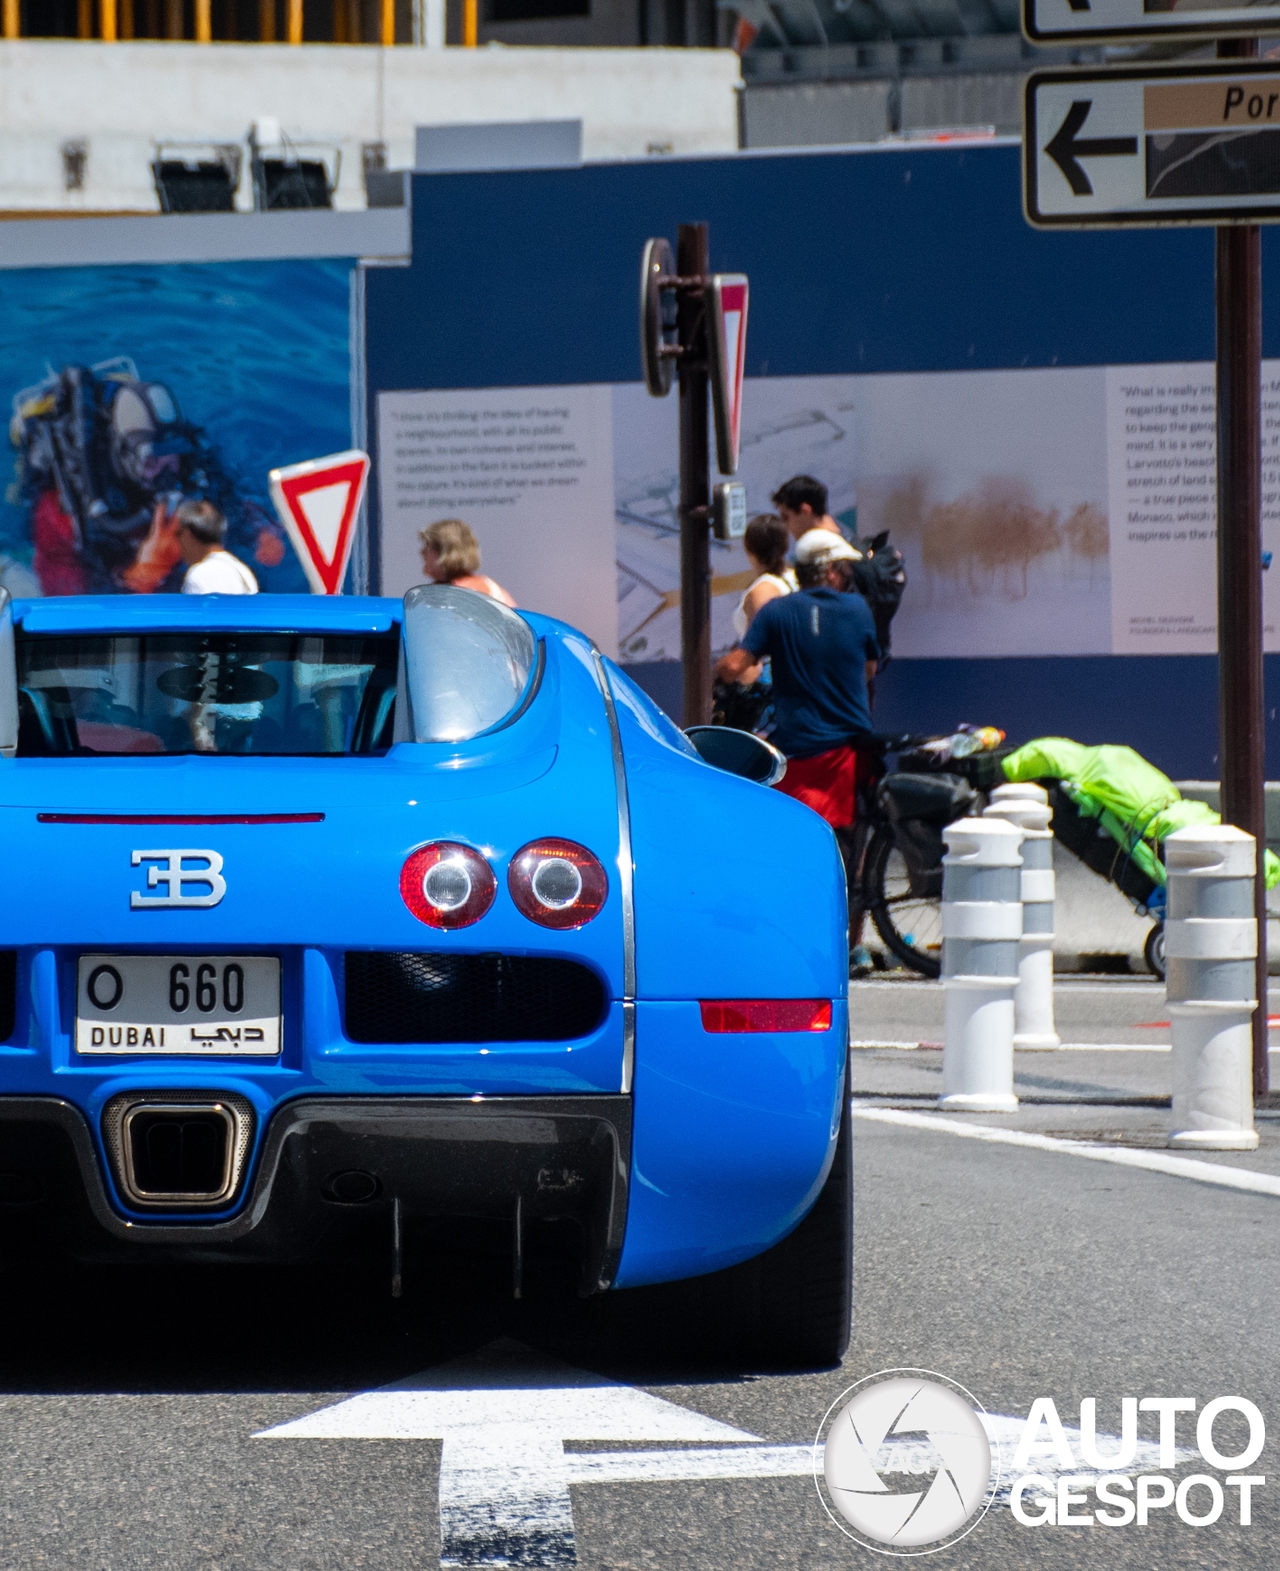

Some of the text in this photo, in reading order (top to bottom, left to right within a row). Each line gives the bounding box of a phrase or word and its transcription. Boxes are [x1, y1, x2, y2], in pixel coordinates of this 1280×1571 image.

[1125, 402, 1179, 417] regarding
[1181, 401, 1199, 412] the
[1170, 421, 1188, 432] the
[169, 963, 245, 1013] 660
[91, 1027, 165, 1047] DUBAI
[191, 1027, 264, 1048] دبي
